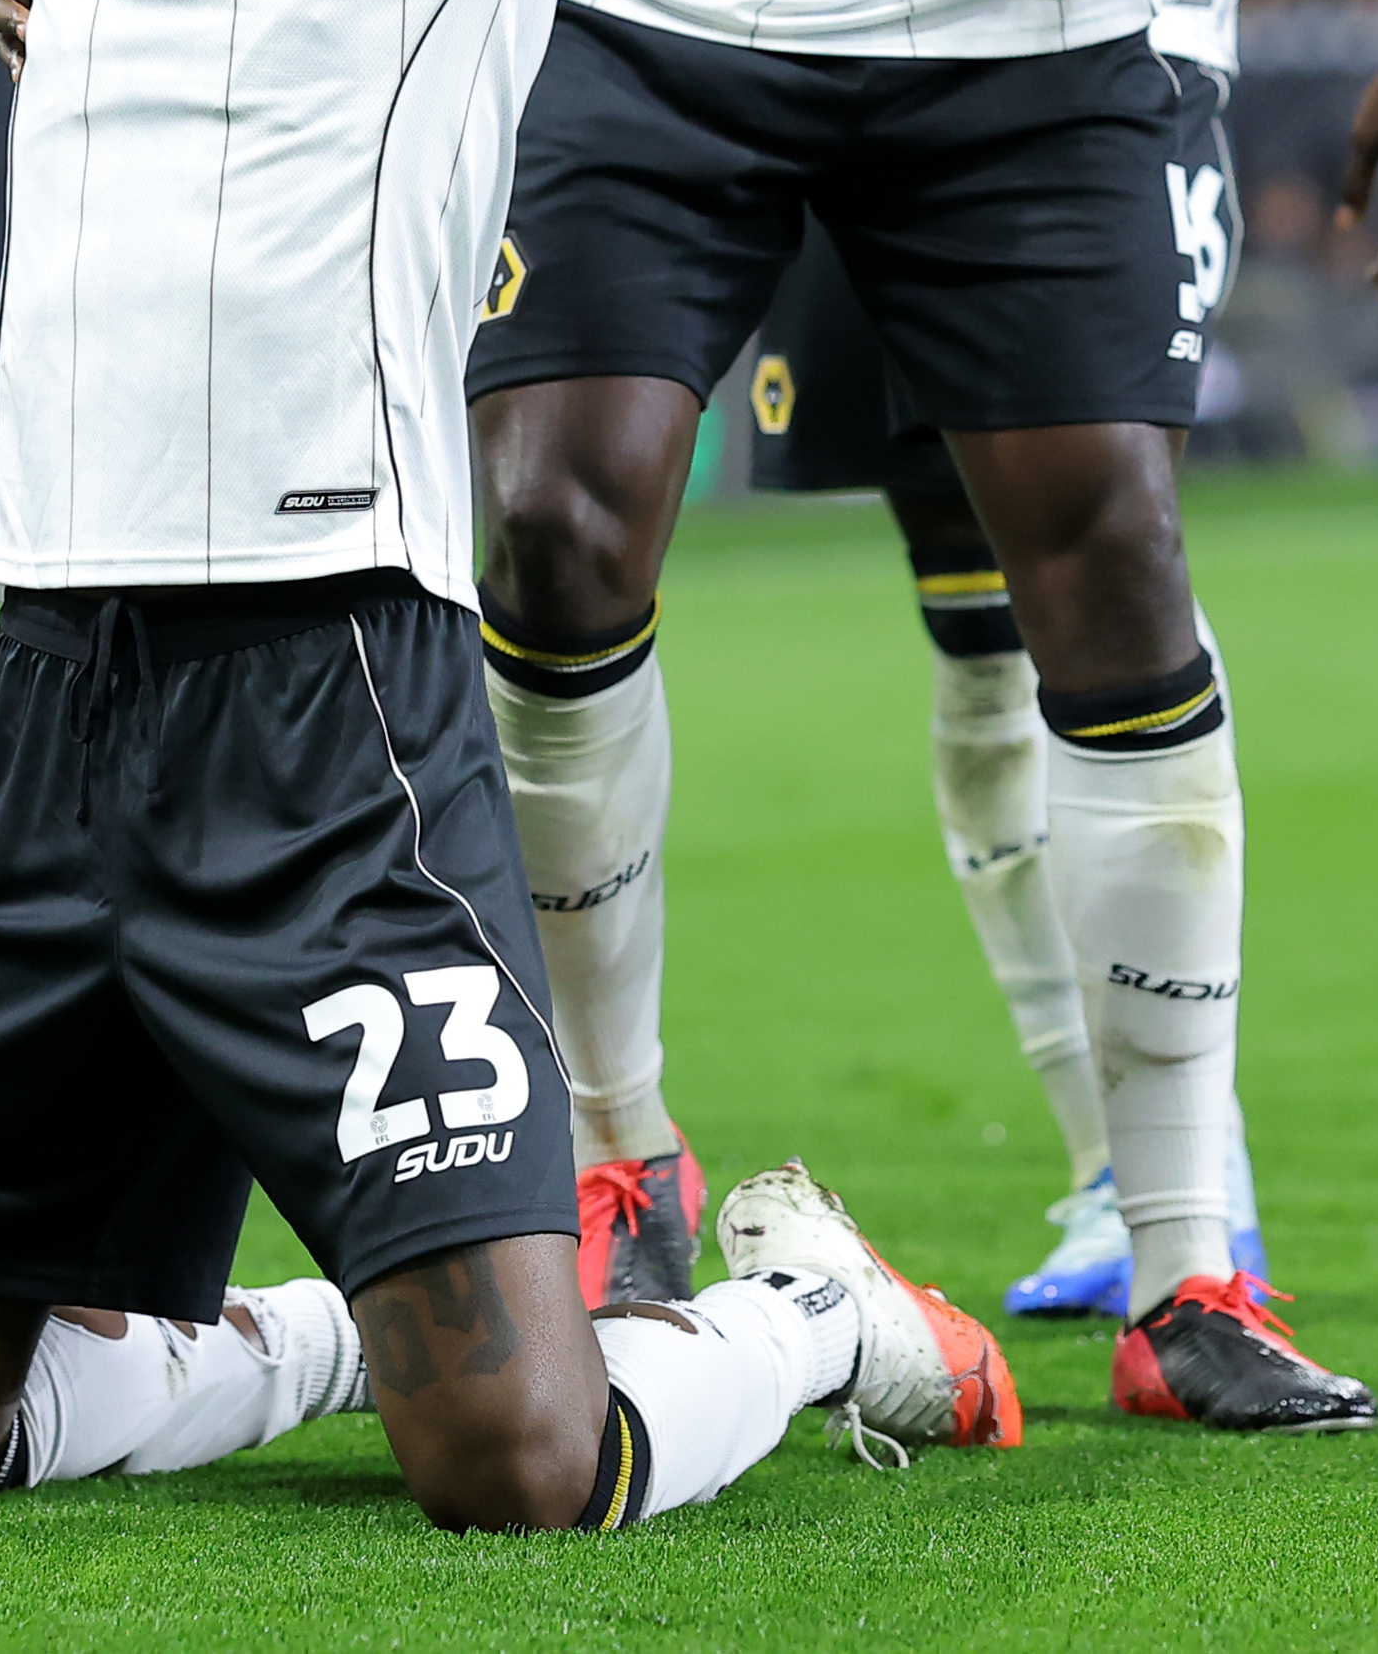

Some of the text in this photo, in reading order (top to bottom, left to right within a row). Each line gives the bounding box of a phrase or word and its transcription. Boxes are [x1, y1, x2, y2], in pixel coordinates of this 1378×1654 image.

[283, 496, 325, 508] SUDU
[1108, 962, 1239, 1000] SUDU
[301, 965, 530, 1164] 23
[482, 1113, 497, 1122] EFL
[375, 1134, 390, 1145] EFL
[394, 1131, 515, 1183] SUDU
